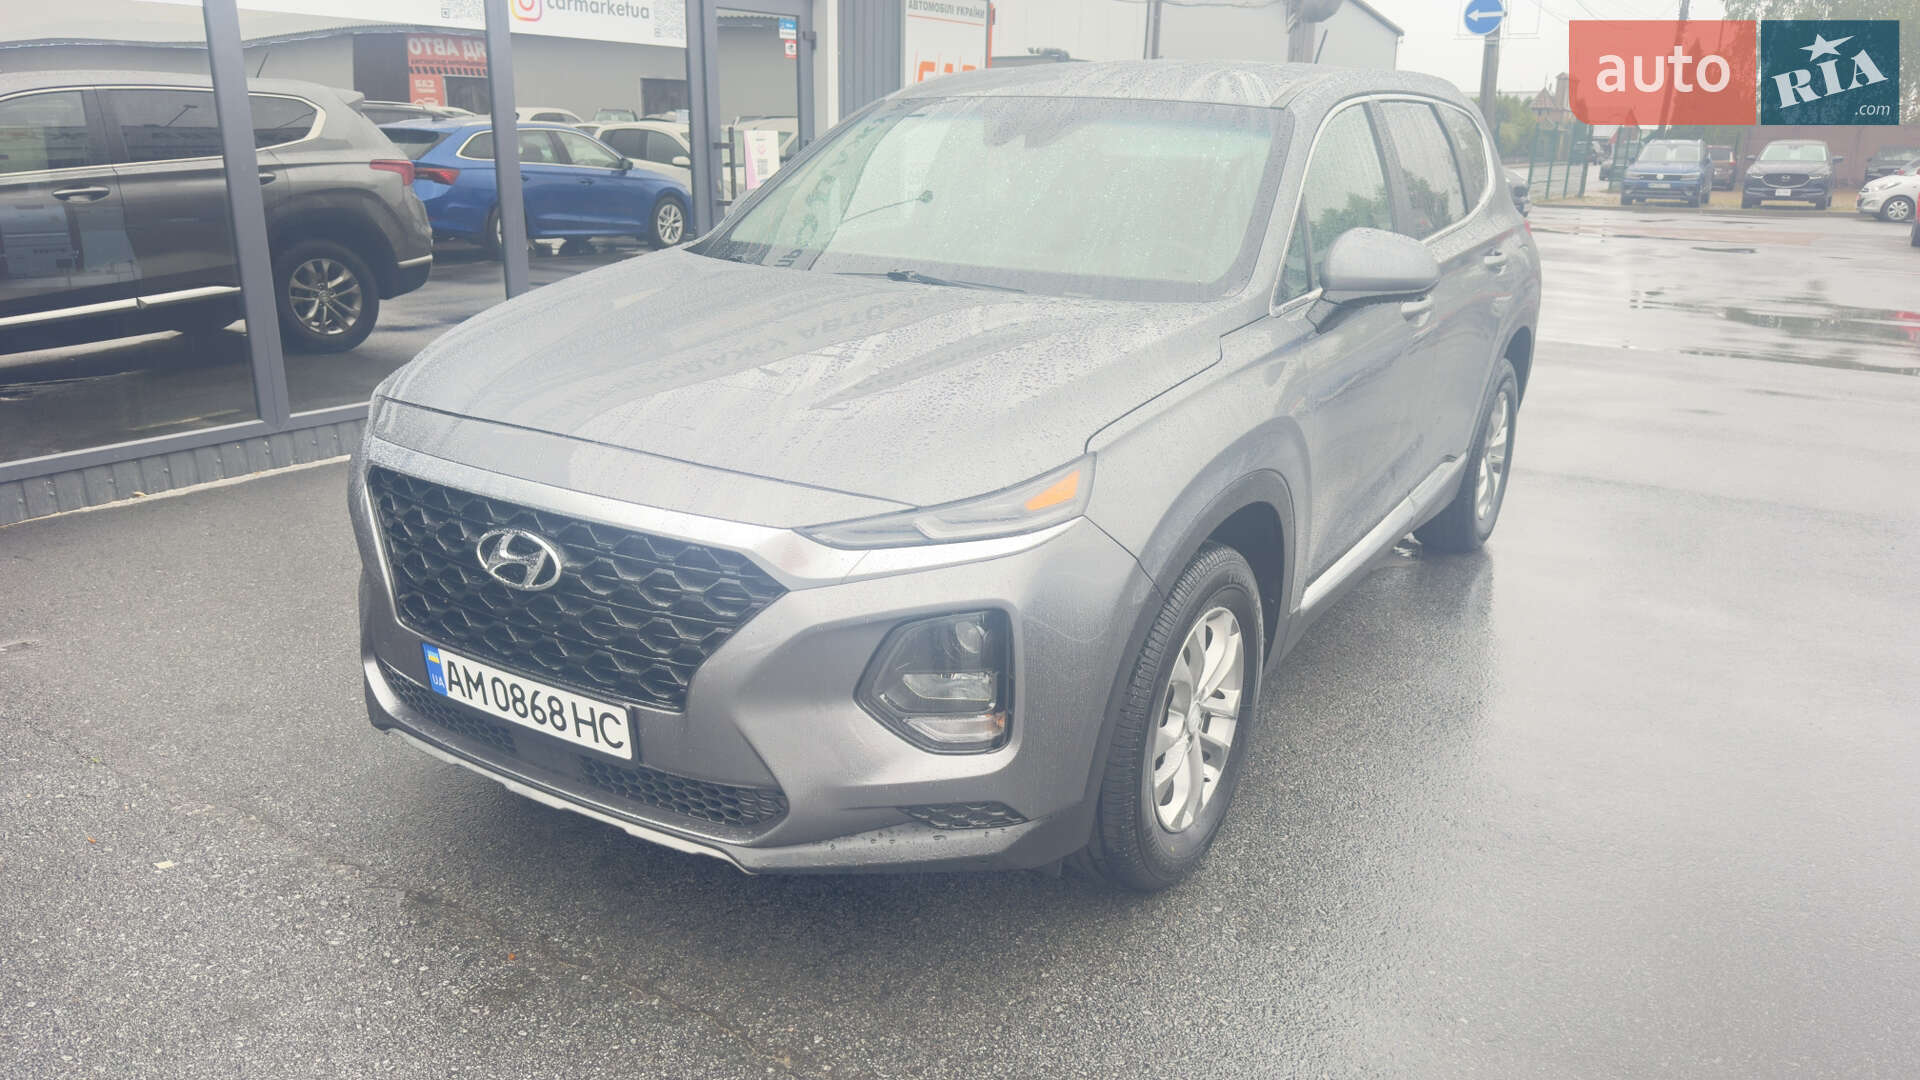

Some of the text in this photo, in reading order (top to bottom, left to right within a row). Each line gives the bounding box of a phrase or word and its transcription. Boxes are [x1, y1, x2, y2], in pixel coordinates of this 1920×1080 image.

[547, 0, 650, 19] carmarketua
[431, 675, 445, 688] UA
[491, 676, 567, 732] 0868
